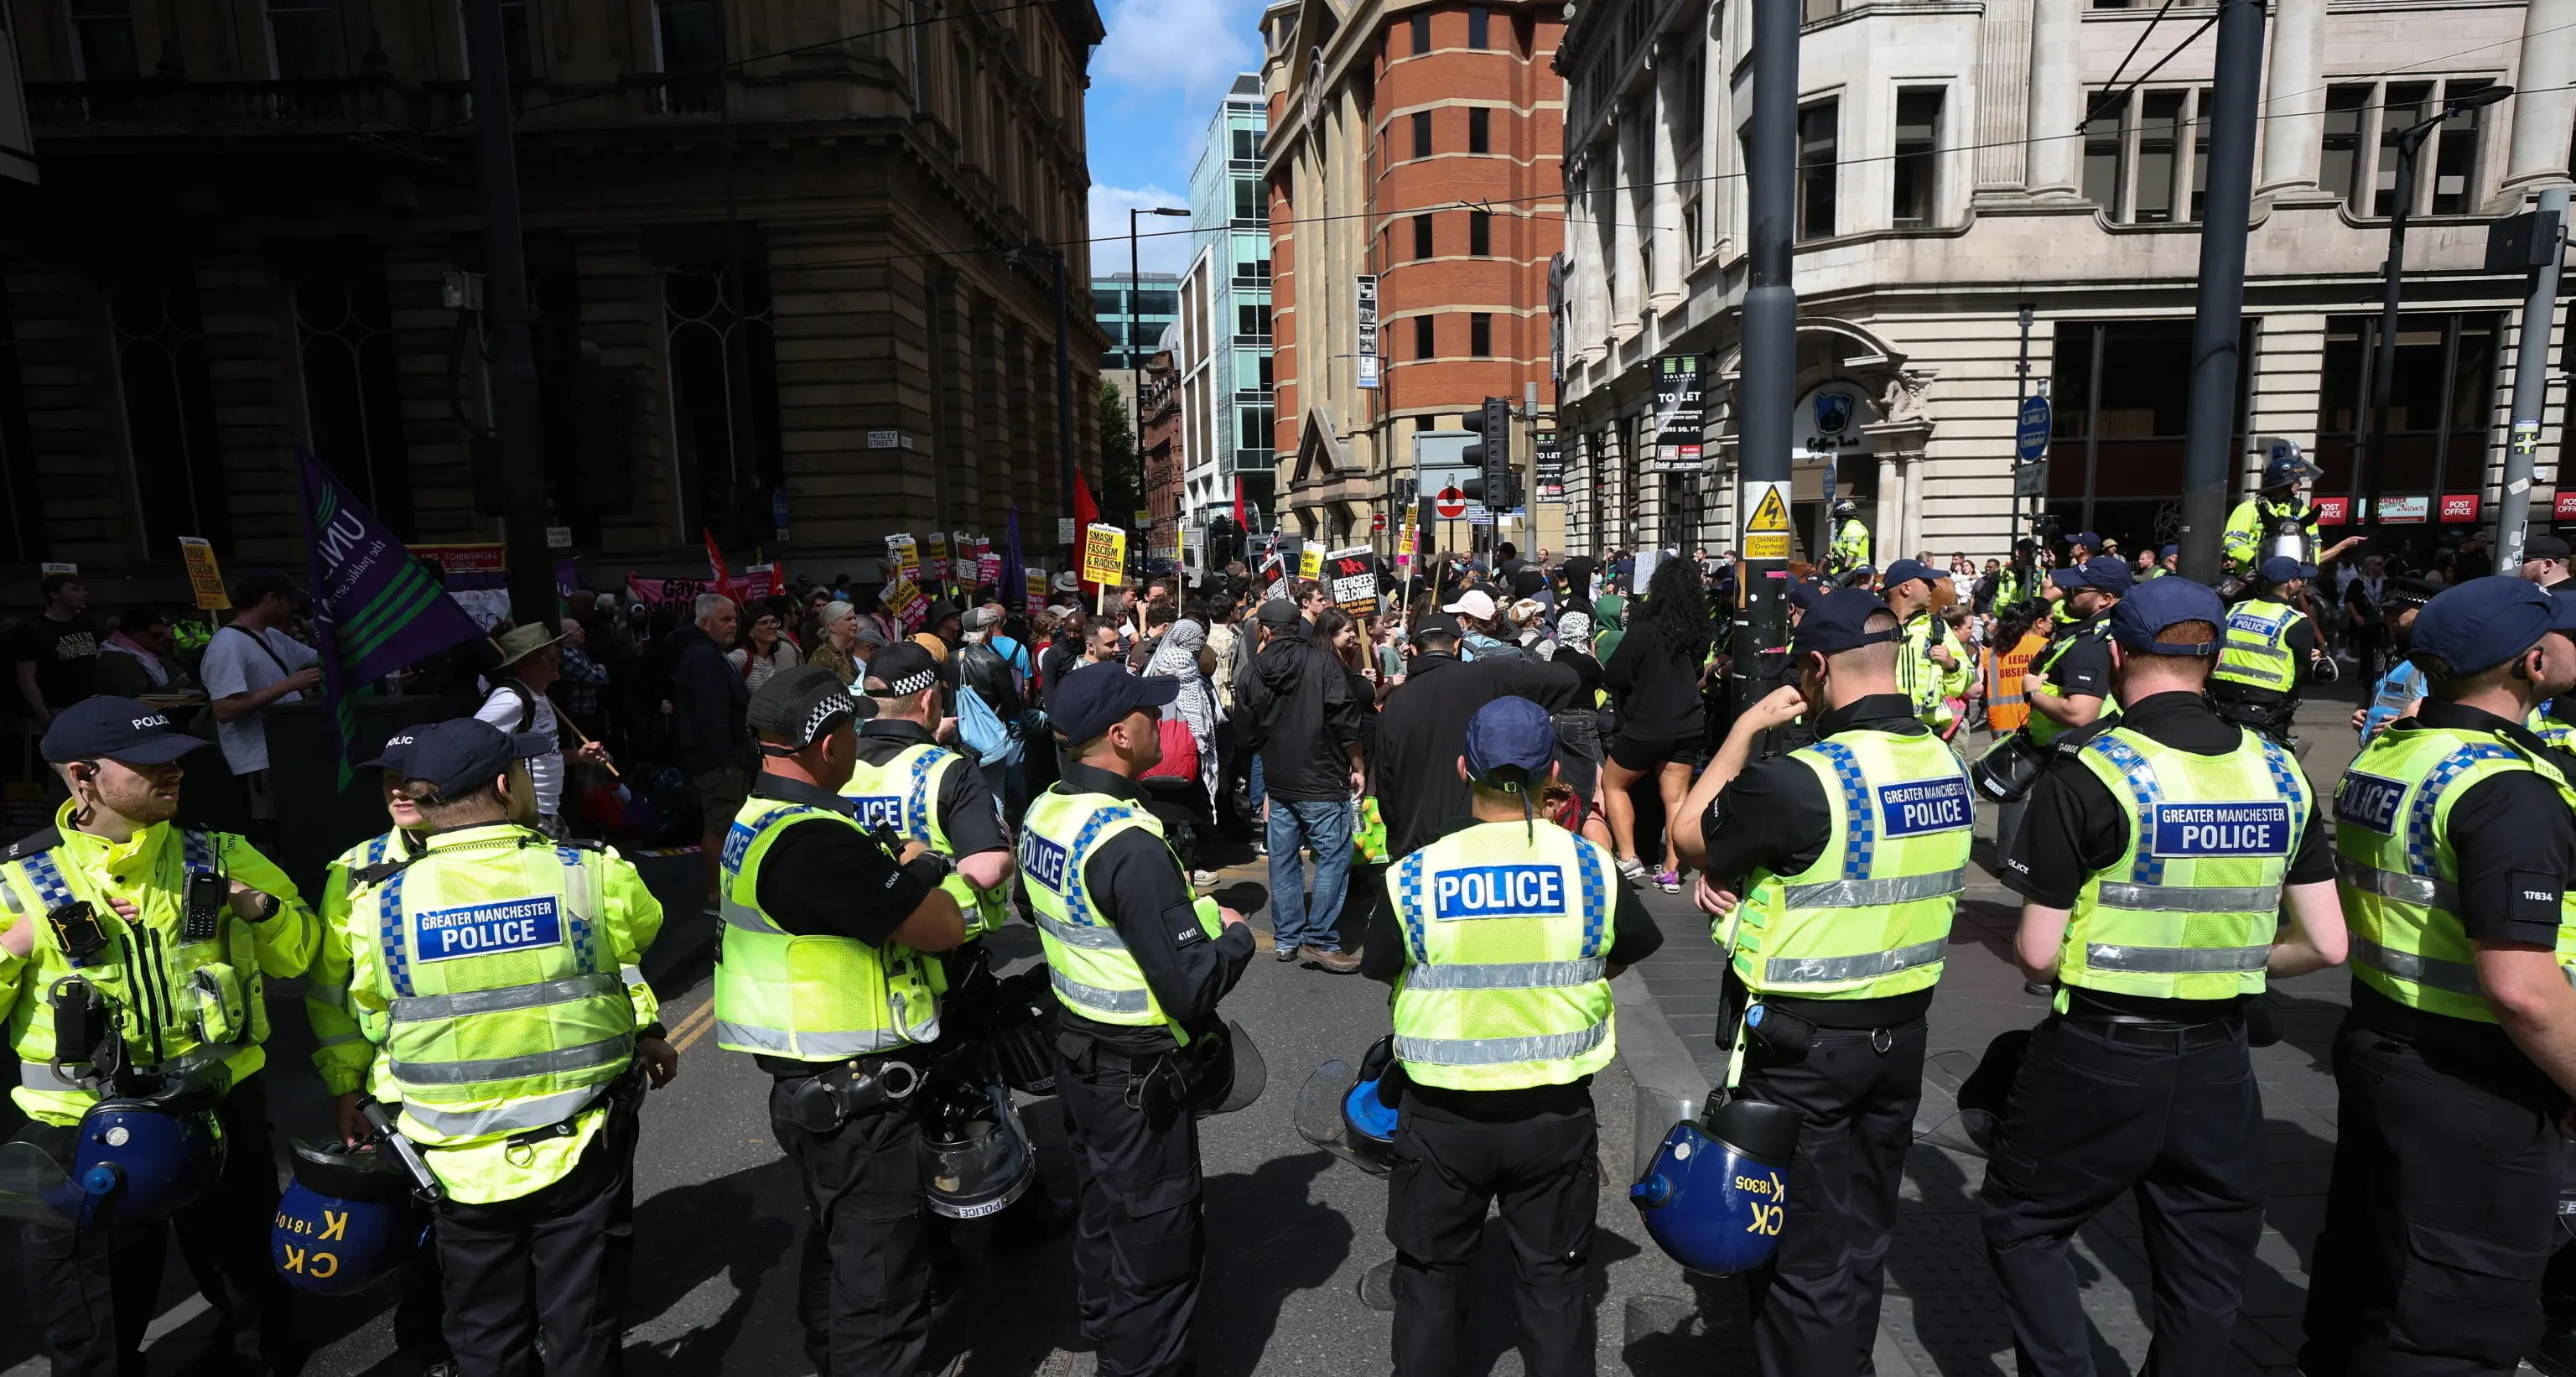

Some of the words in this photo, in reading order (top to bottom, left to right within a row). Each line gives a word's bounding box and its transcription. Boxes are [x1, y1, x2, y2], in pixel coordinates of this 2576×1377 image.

[1658, 392, 1675, 403] TO
[1680, 392, 1701, 402] LET
[869, 432, 896, 440] MOSLEY
[2320, 510, 2341, 518] FFICE
[2401, 503, 2425, 512] News
[2444, 507, 2471, 516] OFFICE
[1088, 530, 1114, 544] SMASH
[444, 550, 498, 559] COMMERCIAL
[1088, 543, 1119, 558] FASCISM
[1351, 547, 1368, 555] Worker
[1086, 555, 1092, 565] &
[1093, 558, 1121, 571] RACISM
[662, 579, 706, 597] Gays
[1332, 573, 1375, 591] REFUGEES
[1333, 585, 1377, 604] WELCOME
[1358, 598, 1376, 606] borders
[2235, 620, 2268, 632] POLICE
[1999, 668, 2029, 678] OBSER
[1884, 787, 1924, 804] GREATER
[1924, 782, 1966, 799] MANCHESTER
[1985, 779, 2005, 796] POLICE
[1903, 798, 1963, 828] POLICE
[2162, 808, 2215, 824] GREATER
[2216, 808, 2285, 823] MANCHESTER
[2182, 824, 2271, 850] POLICE
[885, 870, 901, 890] 02434
[1437, 870, 1560, 912] POLICE
[2523, 891, 2553, 902] 17834
[422, 912, 472, 932] GREATER
[473, 902, 552, 924] MANCHESTER
[441, 919, 537, 953] POLICE
[1178, 928, 1197, 942] 41811
[1028, 1076, 1054, 1091] OLICE
[1736, 1176, 1772, 1195] 18305
[962, 1201, 1001, 1218] POLICE
[276, 1211, 312, 1235] 18101
[318, 1210, 349, 1241] K
[1747, 1202, 1784, 1237] CK
[283, 1244, 339, 1278] CK
